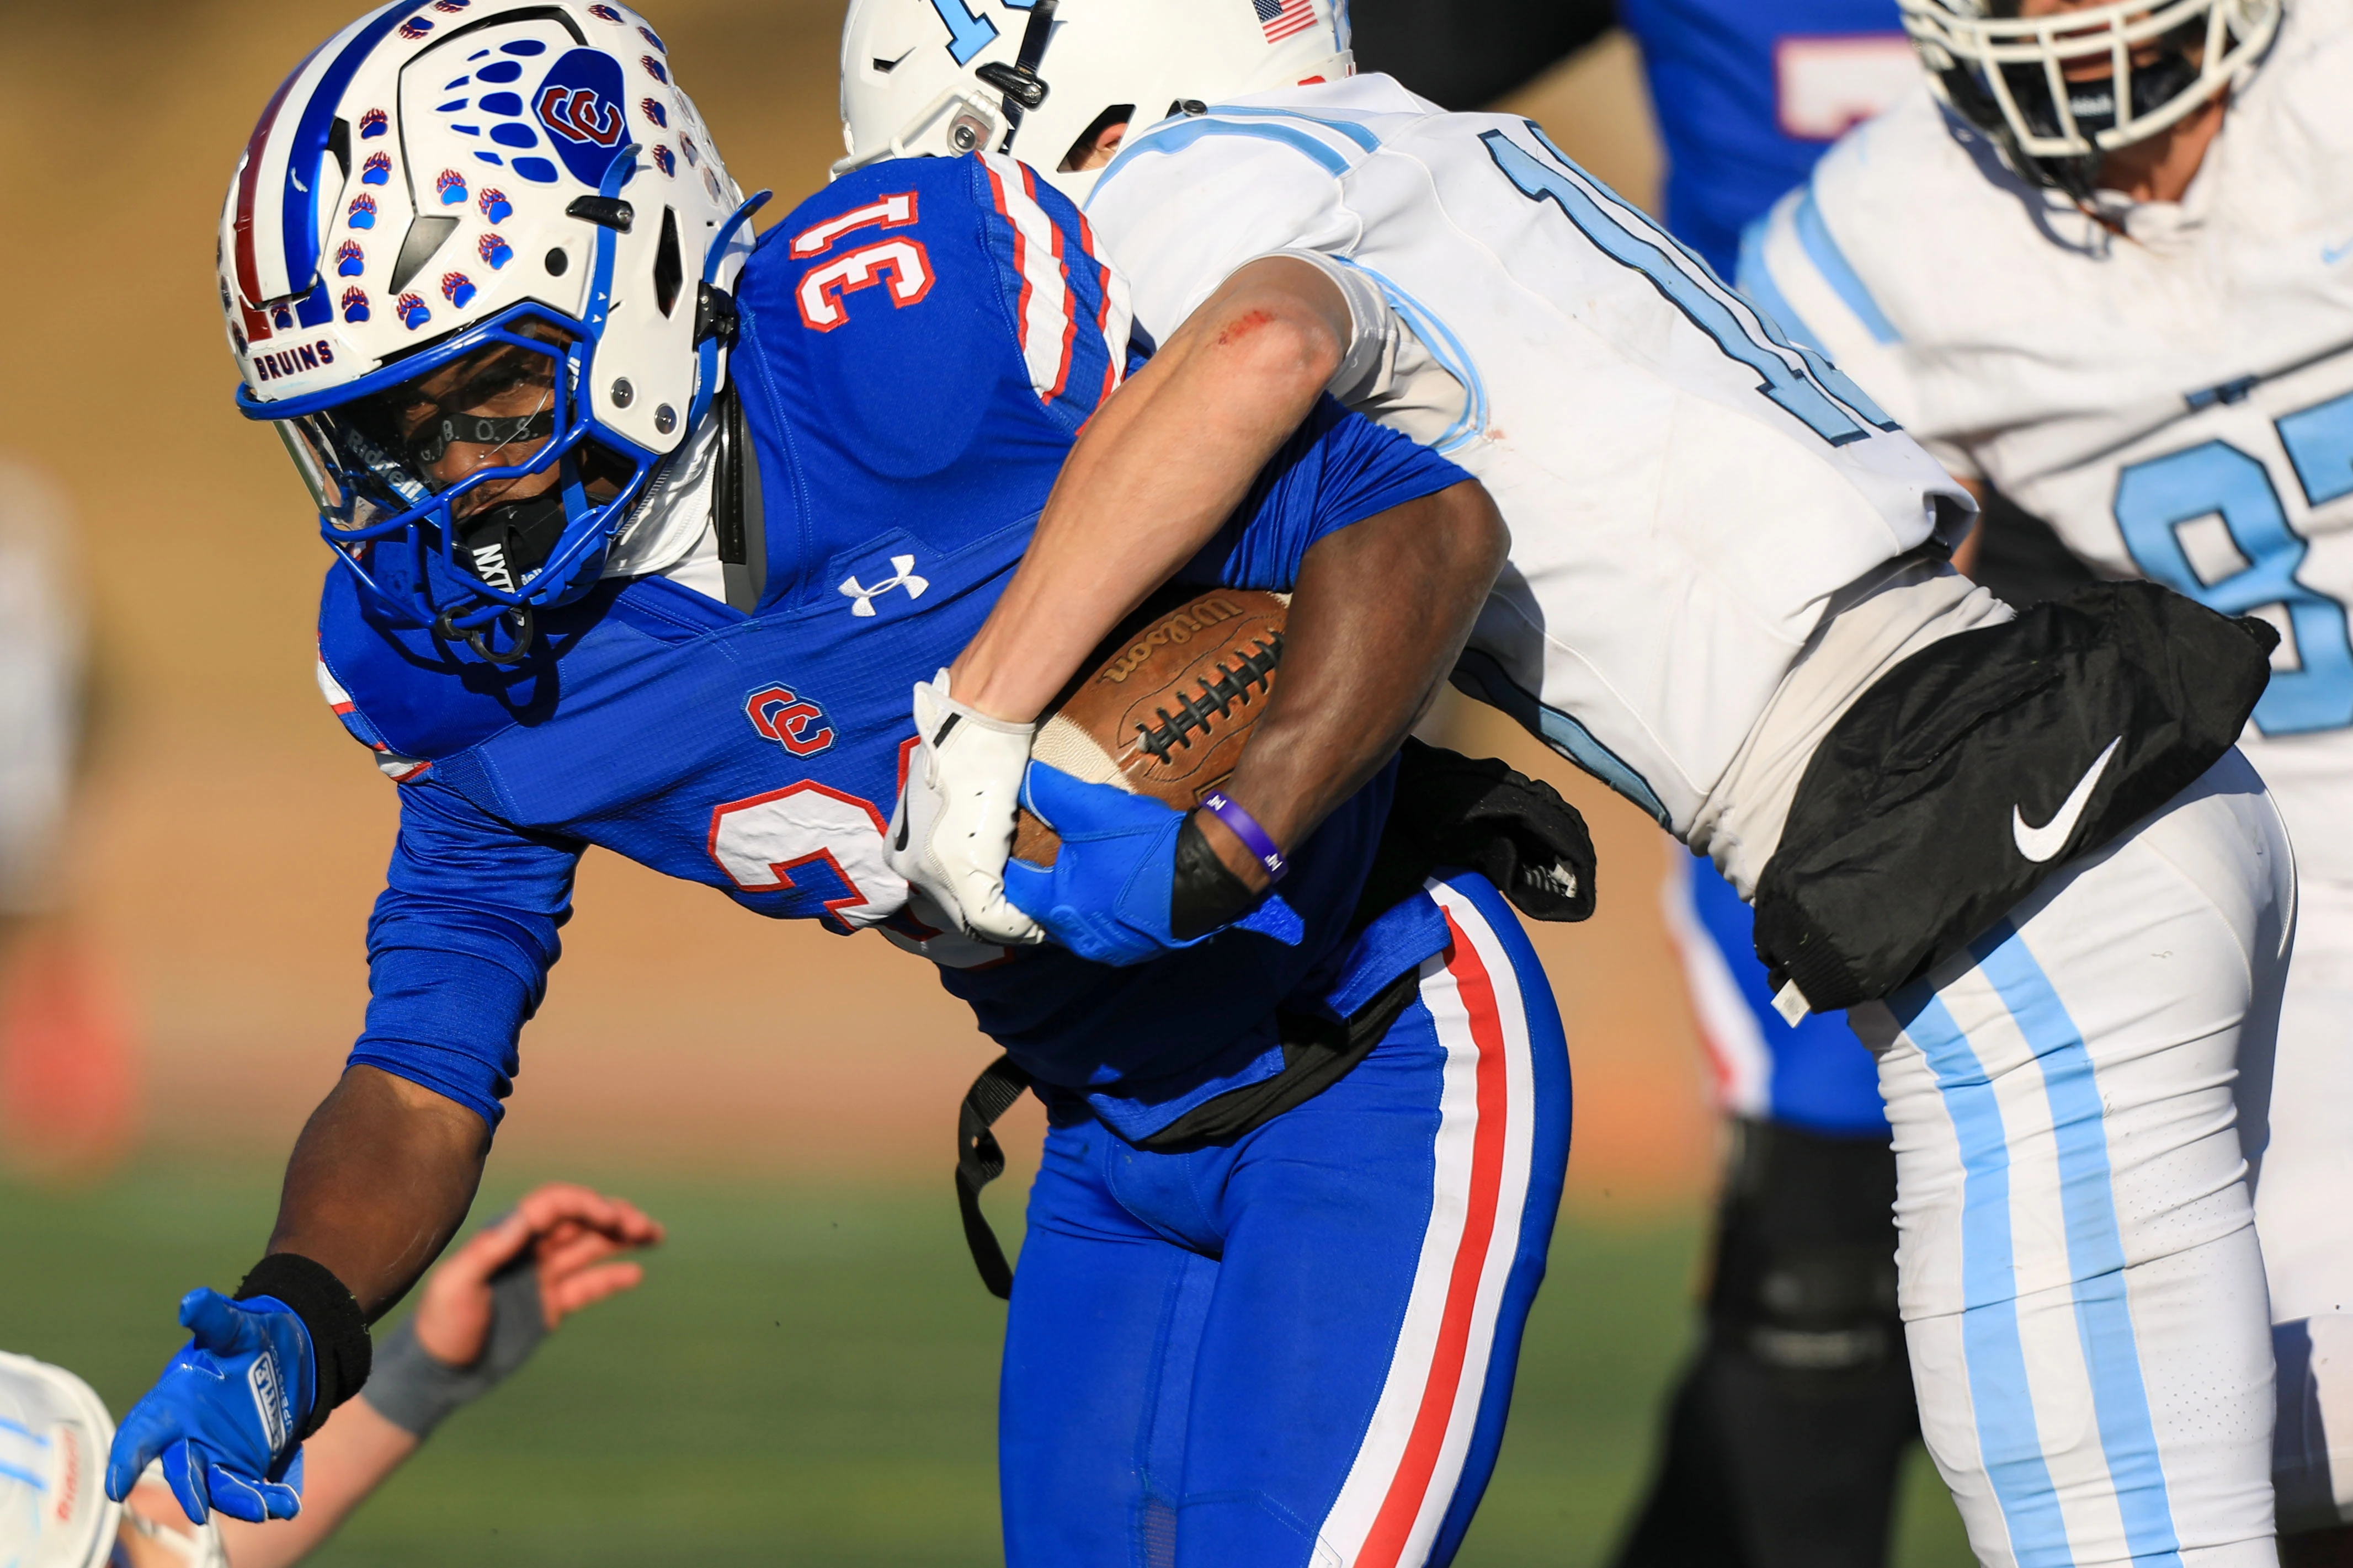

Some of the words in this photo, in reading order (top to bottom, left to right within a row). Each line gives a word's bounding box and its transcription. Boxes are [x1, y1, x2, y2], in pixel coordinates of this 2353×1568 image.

[789, 190, 936, 333] 31
[253, 340, 334, 381] BRUINS
[1096, 598, 1244, 684] Wilson
[744, 685, 835, 757] CC
